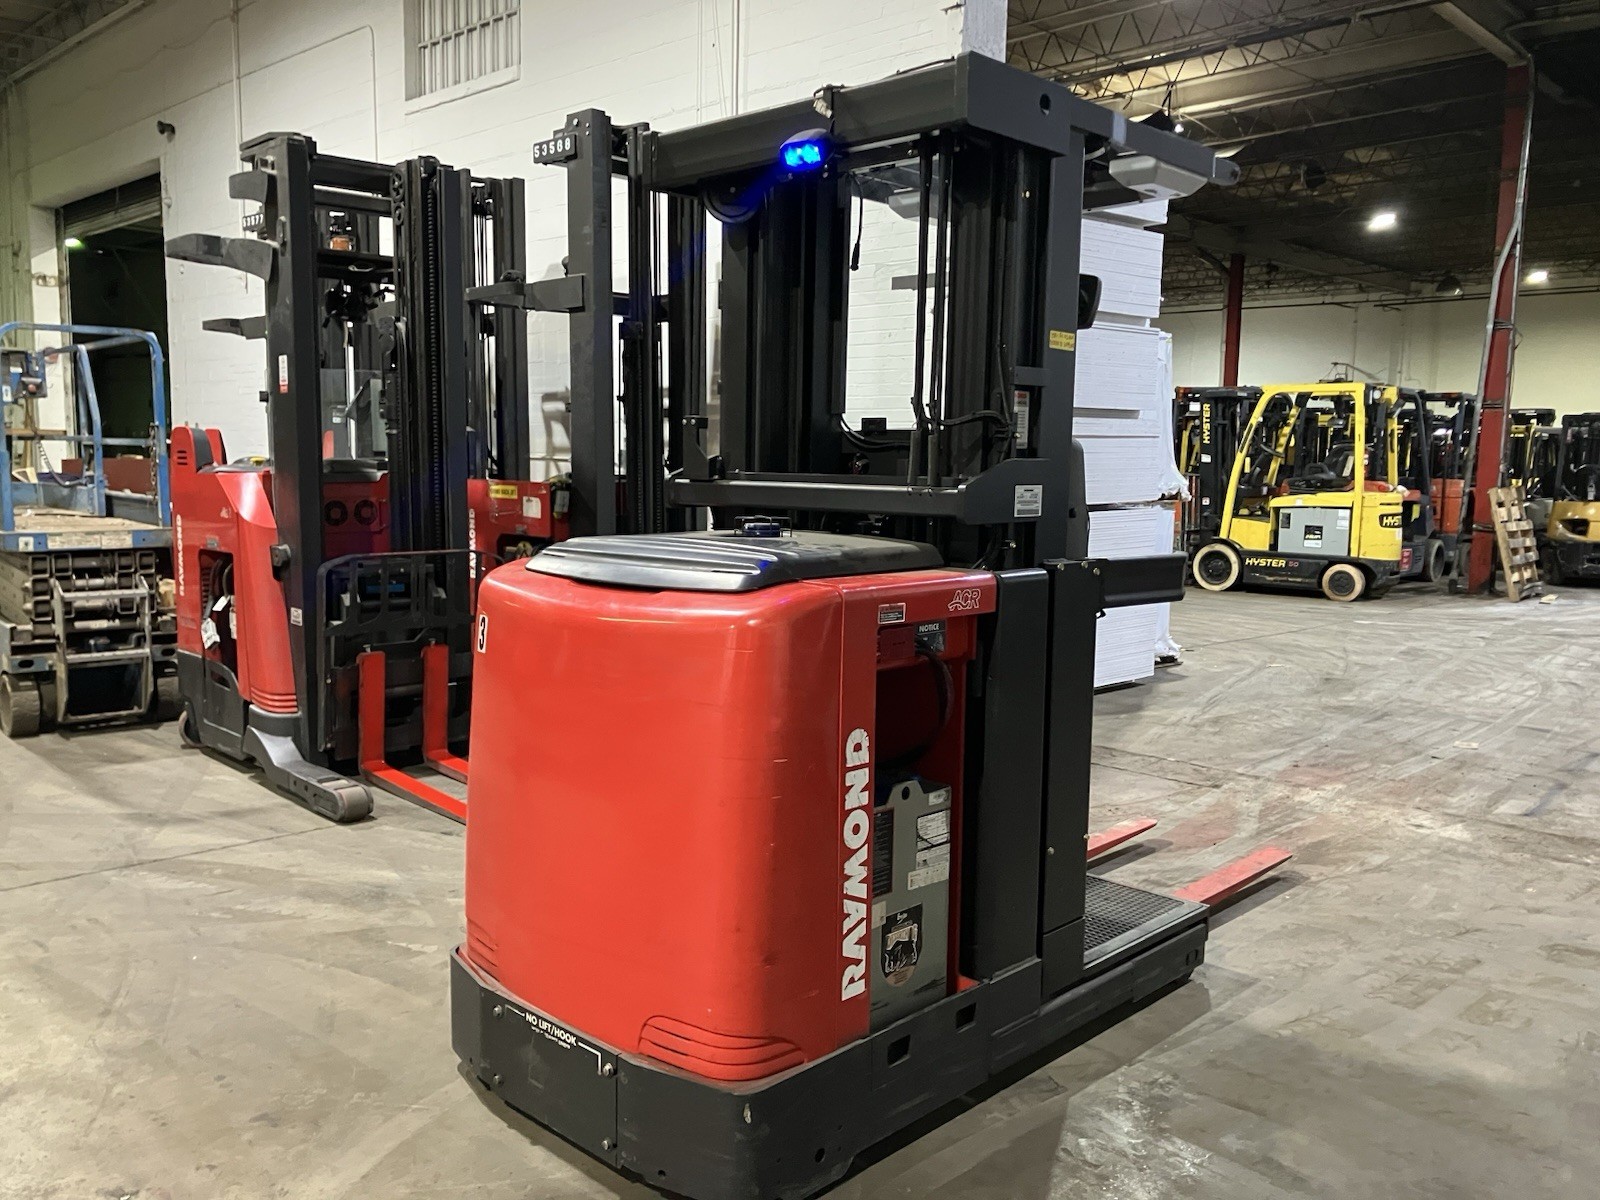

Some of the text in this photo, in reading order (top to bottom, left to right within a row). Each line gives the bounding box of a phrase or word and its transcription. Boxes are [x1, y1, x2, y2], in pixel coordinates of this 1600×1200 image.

[1202, 403, 1211, 444] HYSTER
[1245, 557, 1286, 568] HYSTER
[948, 588, 981, 611] ACR
[478, 616, 486, 651] 3
[919, 623, 940, 633] NOTICE
[841, 728, 870, 1001] RAYMOND
[525, 1012, 538, 1026] NO
[538, 1018, 577, 1047] LIFT/HOOK
